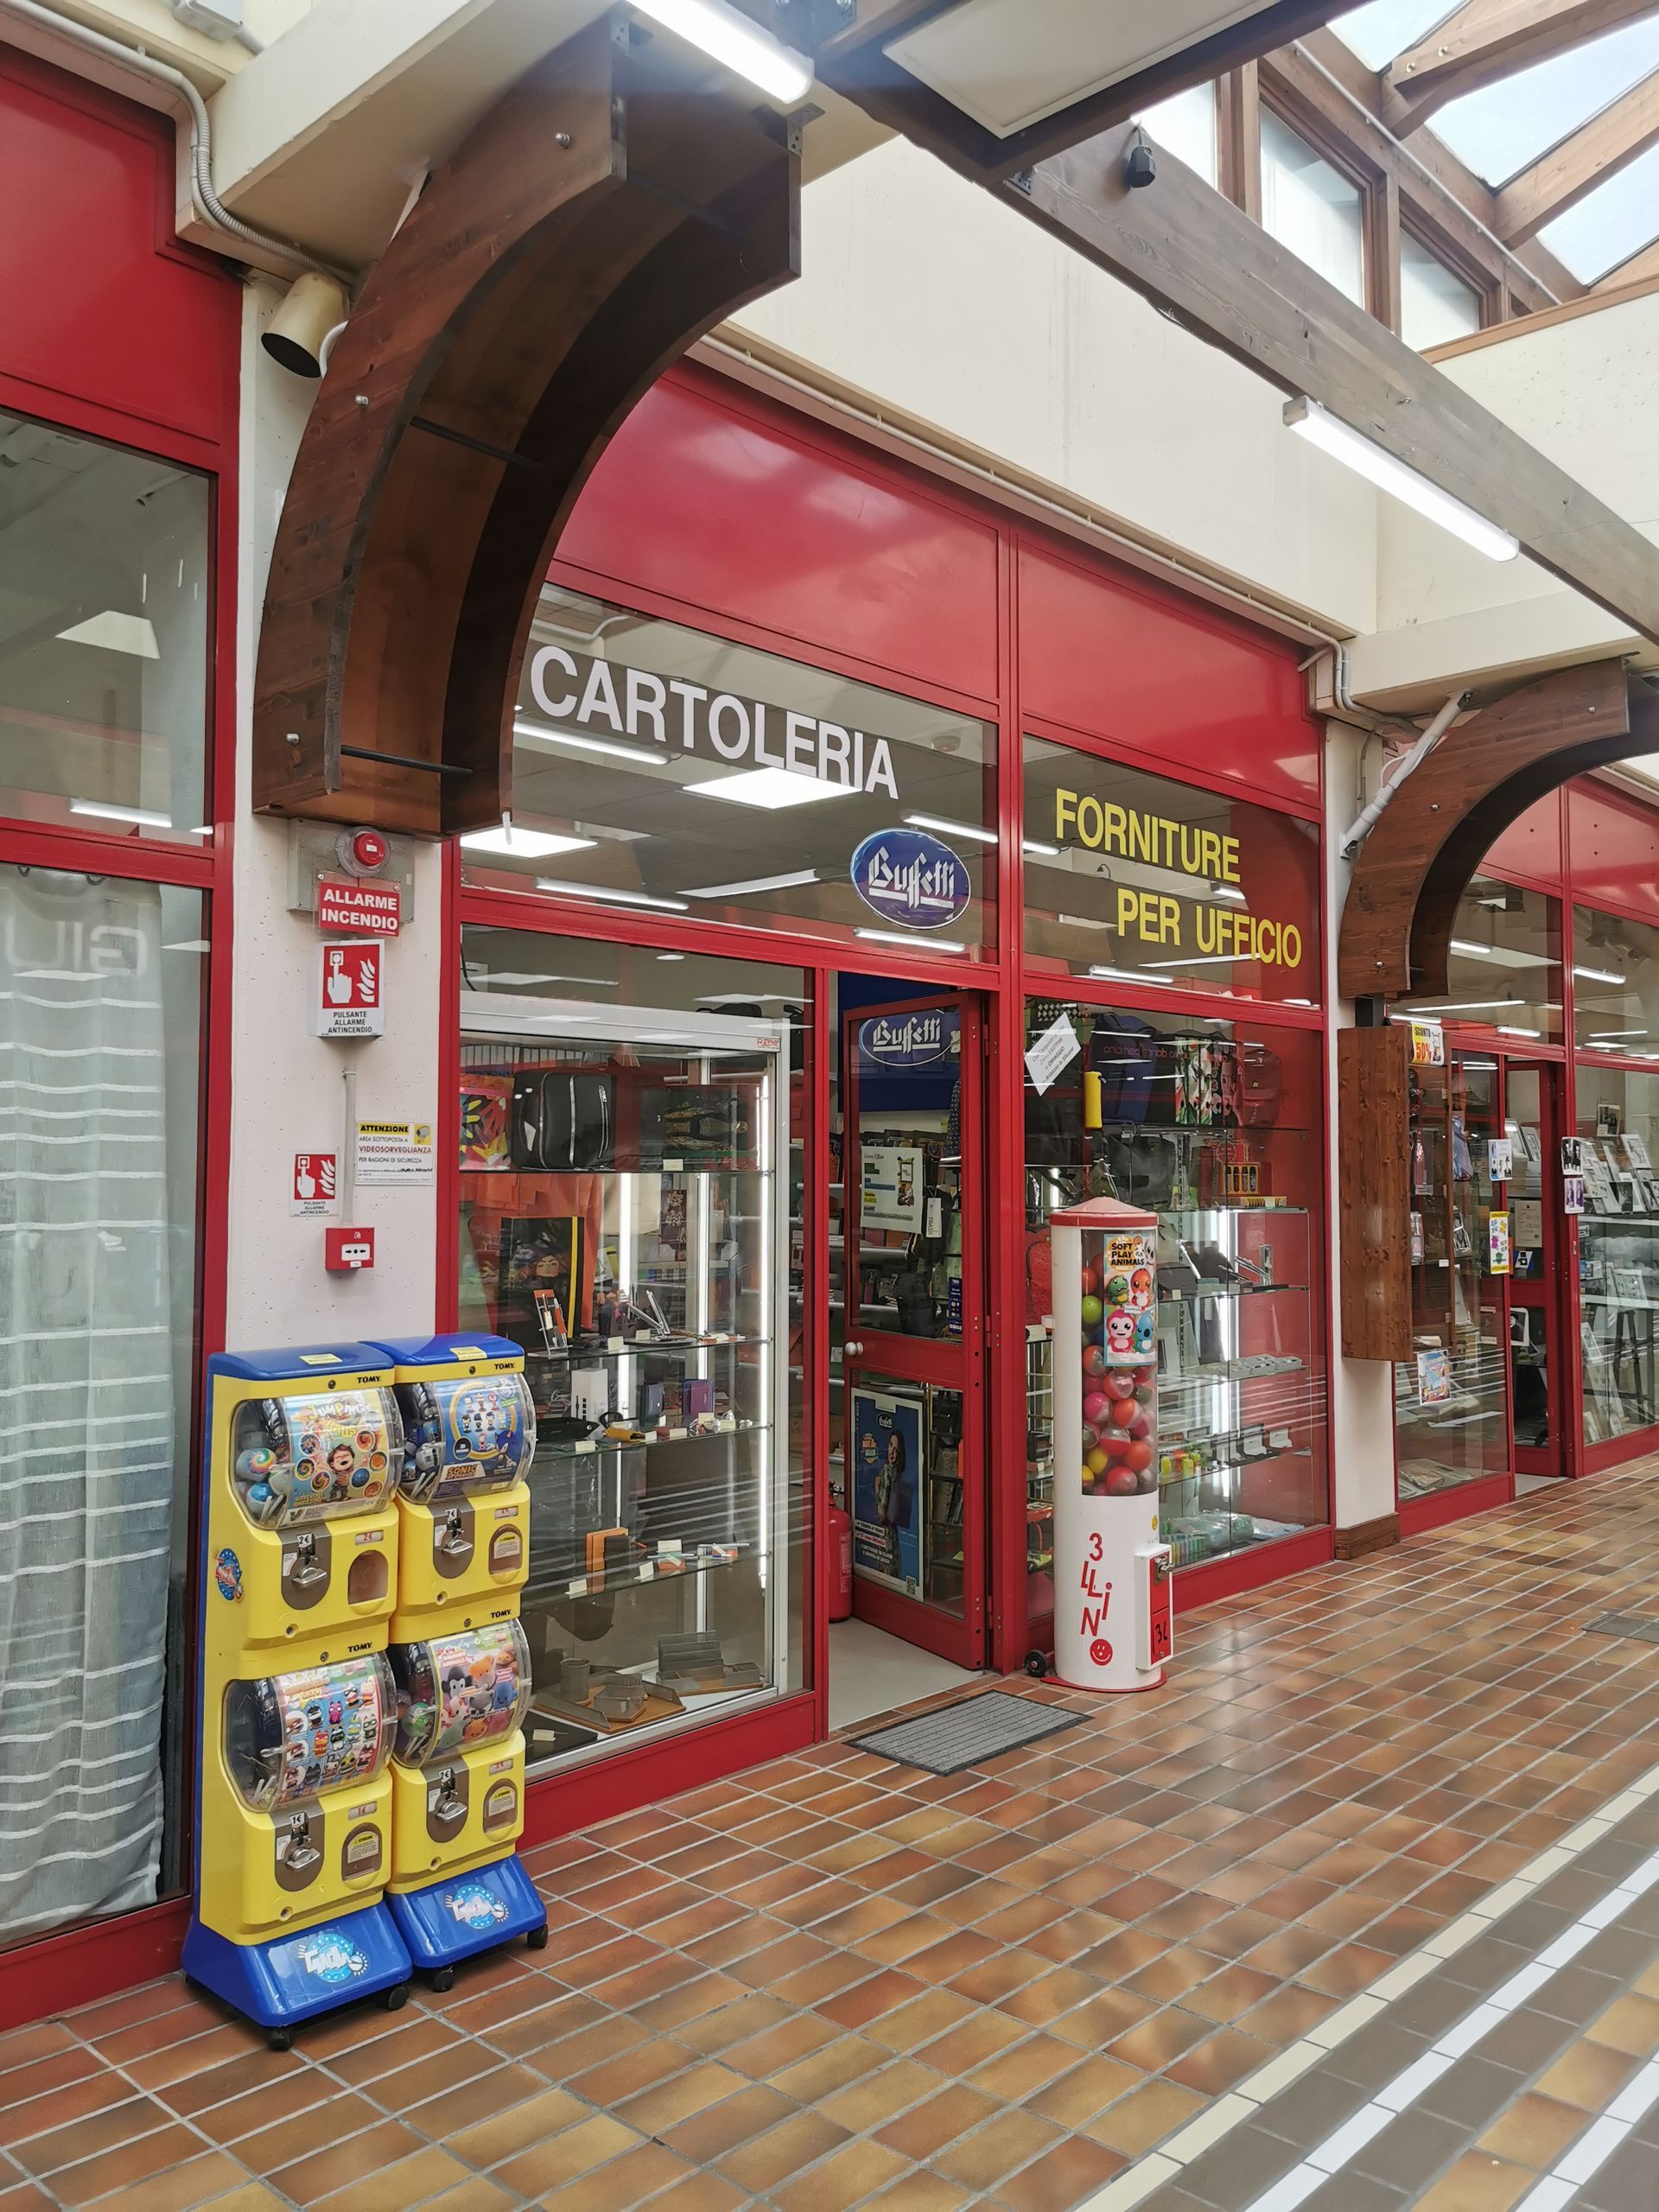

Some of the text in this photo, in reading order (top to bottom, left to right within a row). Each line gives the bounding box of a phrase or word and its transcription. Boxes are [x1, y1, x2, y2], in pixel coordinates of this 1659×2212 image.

[531, 645, 899, 799] CARTOLERIA
[1056, 787, 1241, 883] FORNITURE
[868, 846, 954, 909] Buffetti
[323, 888, 397, 911] ALLARME
[321, 908, 398, 931] INCENDIO
[1117, 888, 1302, 968] PER UFFICIO
[873, 1016, 940, 1054] Buffetti
[1111, 1250, 1133, 1259] PLAY
[448, 1464, 478, 1474] SONIC
[299, 1535, 310, 1544] 2€
[1089, 1533, 1103, 1561] 3
[491, 1609, 512, 1618] TOMY
[347, 1643, 373, 1653] TOMY
[440, 1770, 450, 1779] 2€
[292, 1815, 302, 1825] 1€
